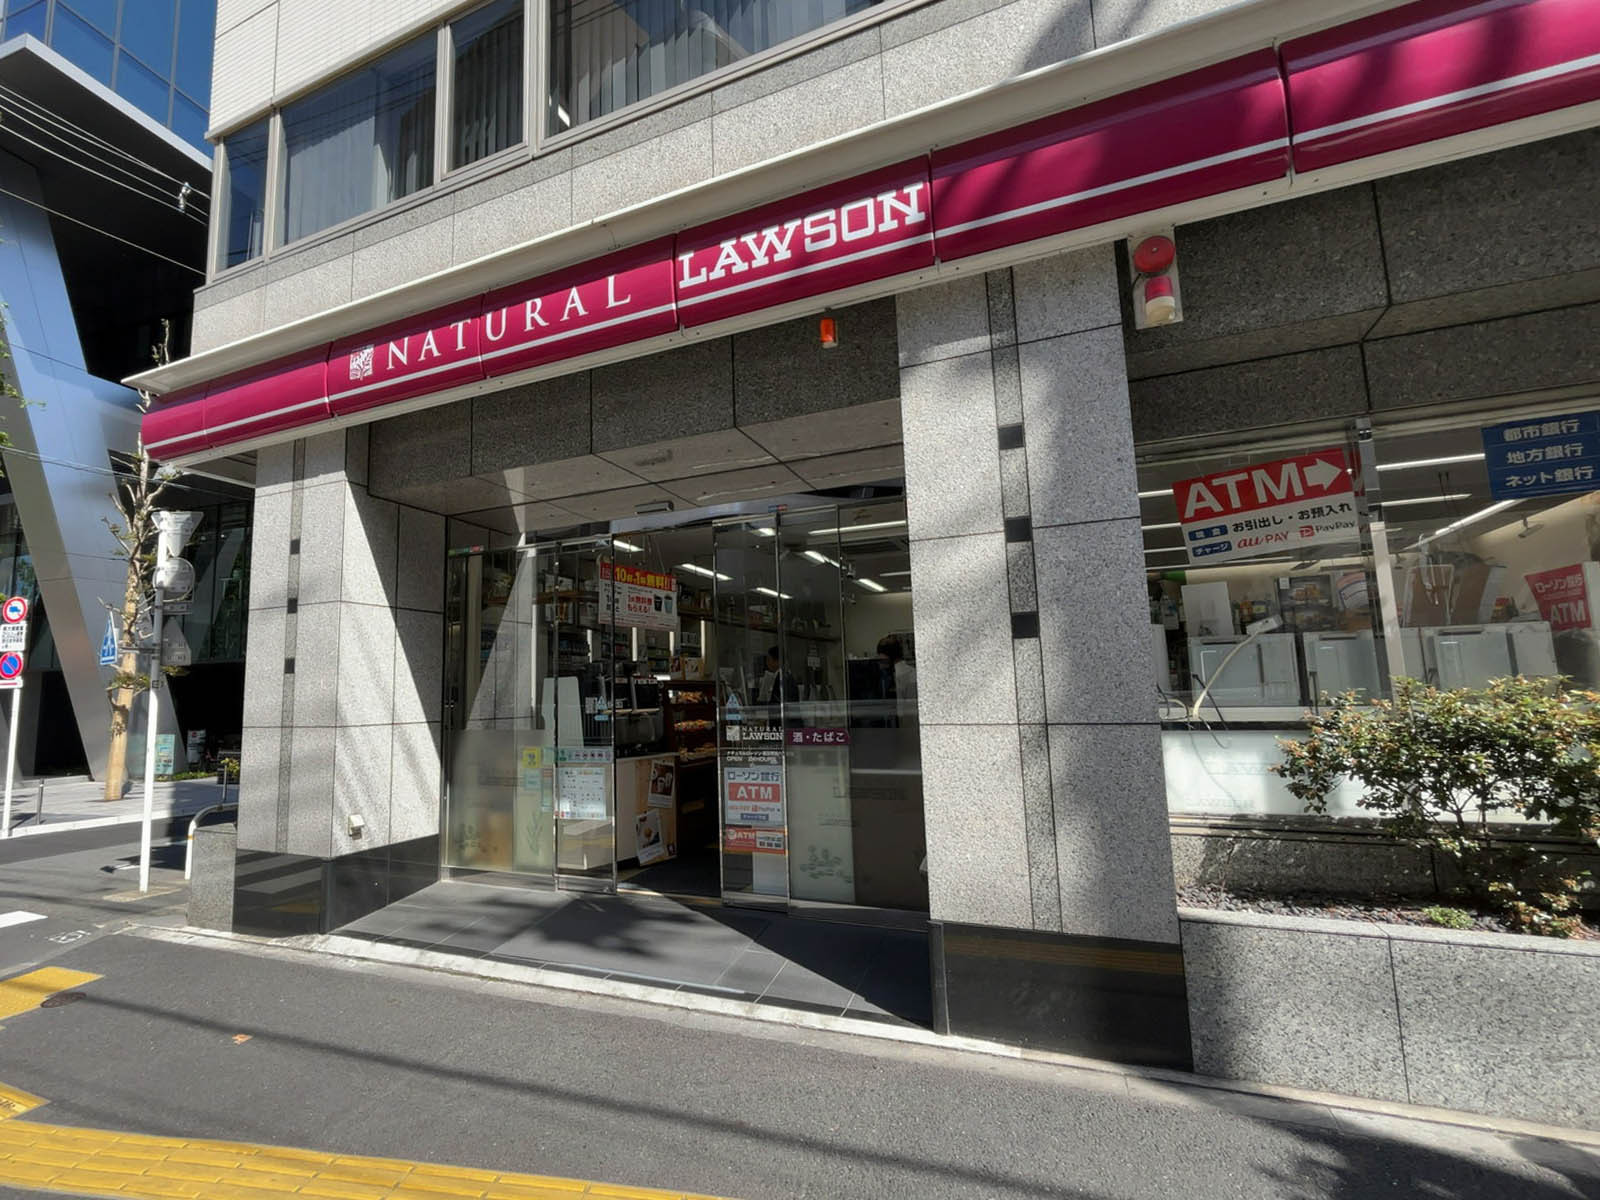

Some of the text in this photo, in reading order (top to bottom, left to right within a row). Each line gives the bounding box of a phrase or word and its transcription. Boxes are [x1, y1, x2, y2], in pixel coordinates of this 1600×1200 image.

[386, 182, 926, 370] NATURAL LAWSON
[1503, 419, 1580, 441] 都市銀行
[1506, 443, 1584, 464] 地方銀行
[1505, 466, 1595, 487] ネット銀行
[1184, 462, 1304, 519] ATM
[1315, 521, 1356, 534] PayPay
[1551, 599, 1587, 625] ATM
[742, 732, 784, 740] LAWSON
[792, 731, 846, 743] 酒・たばこ
[727, 771, 780, 782] ローソン銀行
[737, 785, 773, 800] ATM
